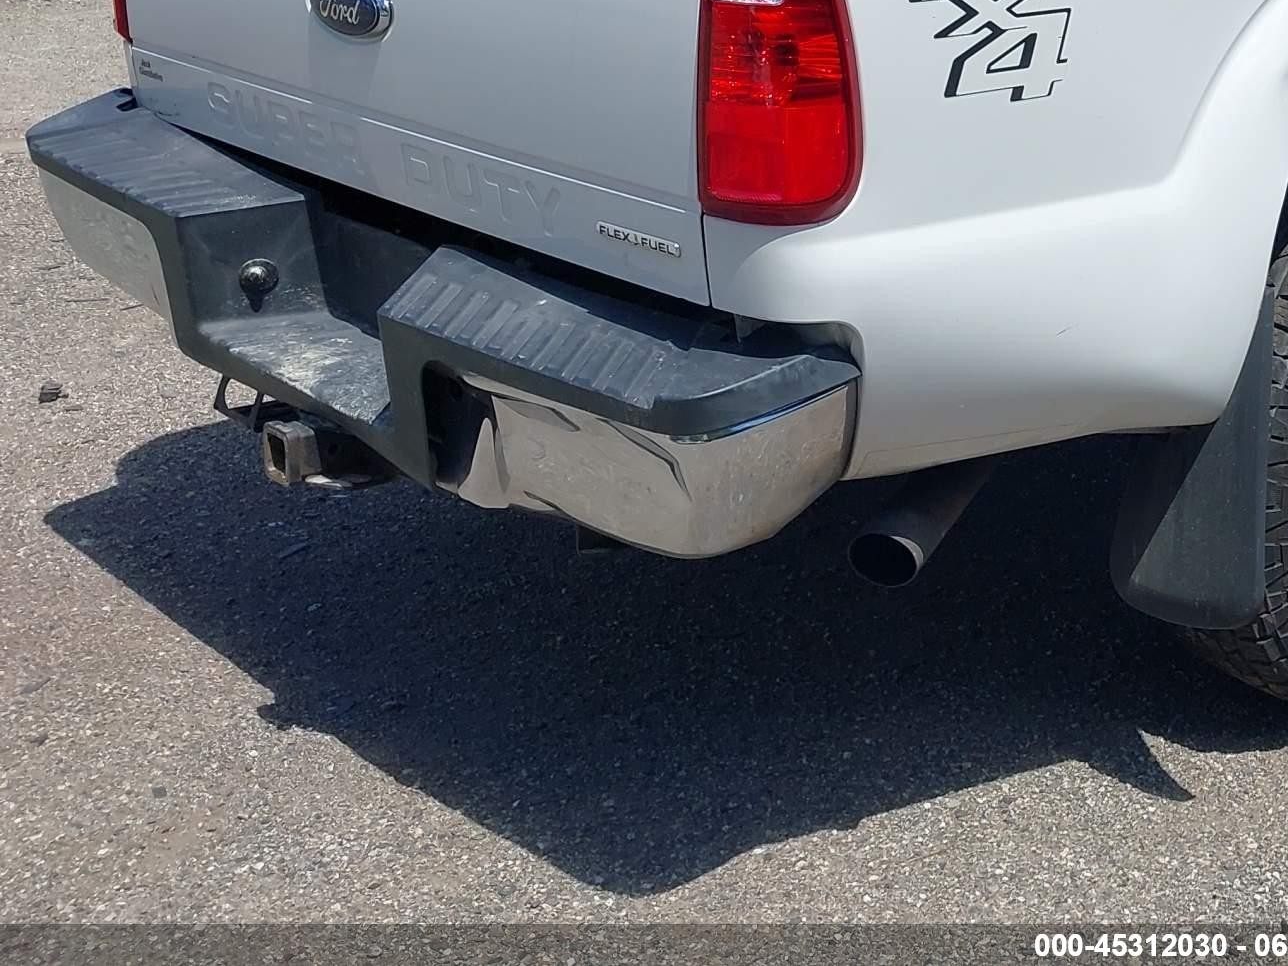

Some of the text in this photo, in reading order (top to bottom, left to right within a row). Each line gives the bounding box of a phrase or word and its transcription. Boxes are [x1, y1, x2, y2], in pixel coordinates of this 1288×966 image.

[206, 81, 562, 238] SUPER DUTY
[599, 225, 676, 256] FLEX FUEL
